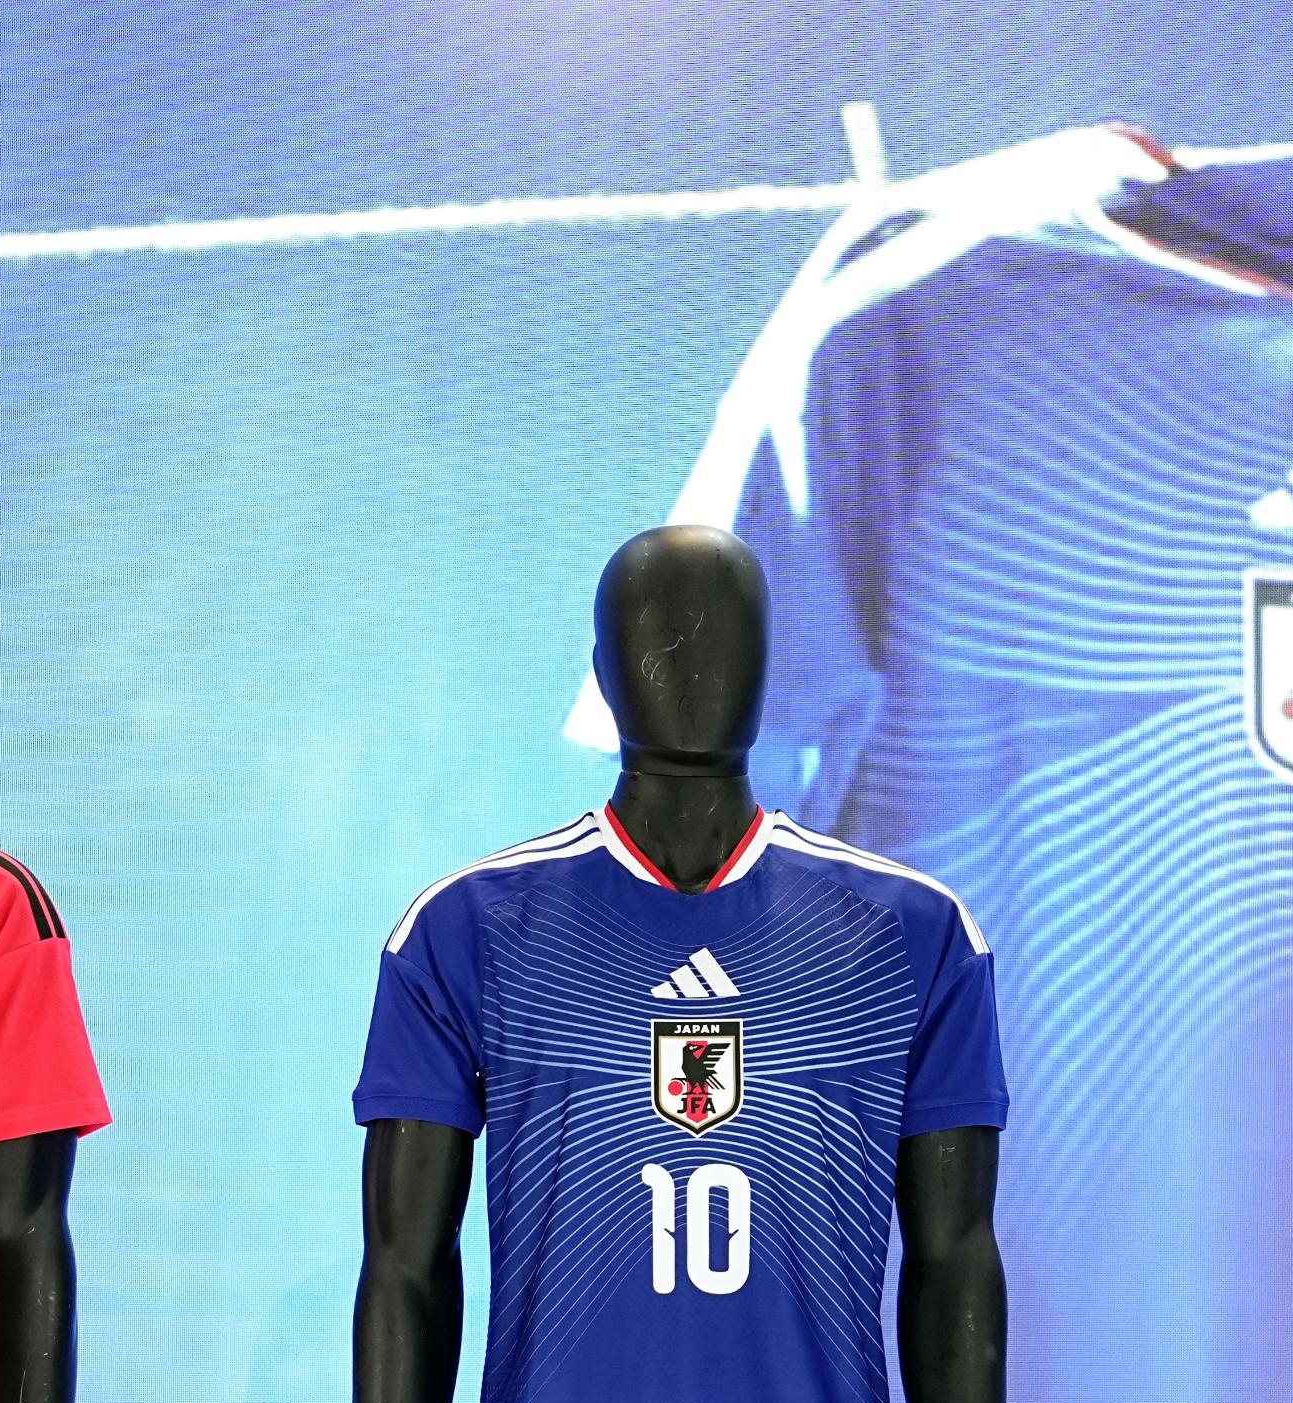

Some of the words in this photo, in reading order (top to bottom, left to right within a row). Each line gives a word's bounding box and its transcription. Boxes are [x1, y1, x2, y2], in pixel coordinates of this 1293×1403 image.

[674, 1024, 720, 1034] JAPAN
[676, 1097, 717, 1114] JFA
[641, 1163, 751, 1295] 10
